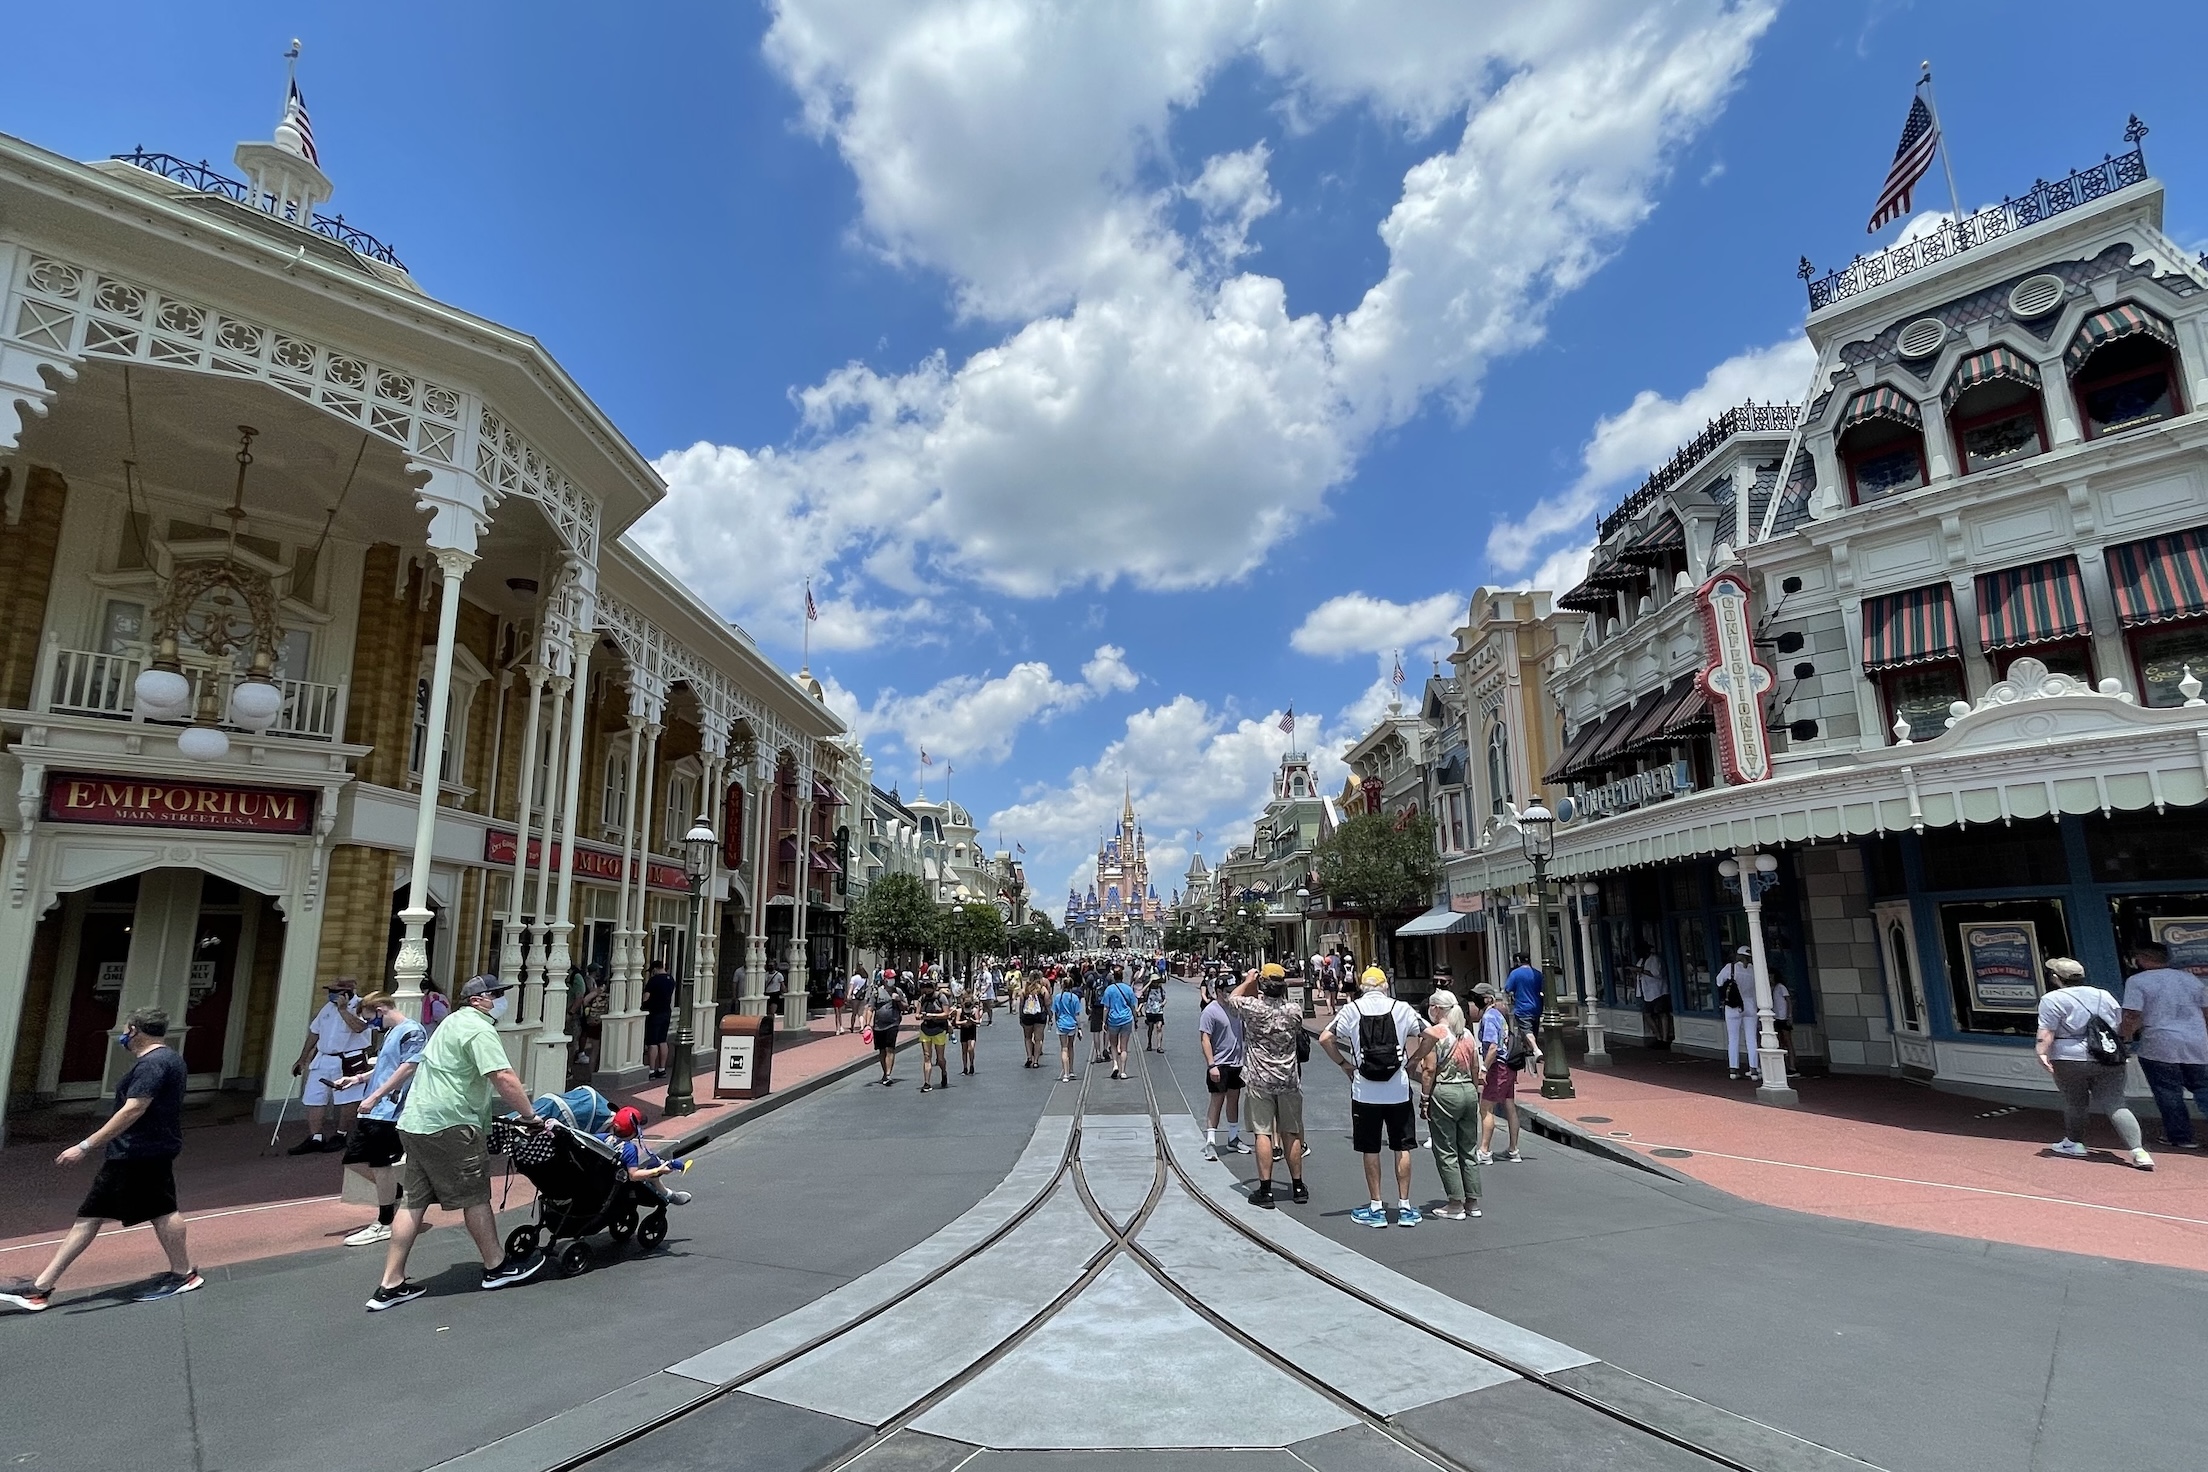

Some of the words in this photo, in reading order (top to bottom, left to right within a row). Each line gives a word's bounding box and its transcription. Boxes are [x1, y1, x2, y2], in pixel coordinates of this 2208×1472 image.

[1722, 597, 1758, 769] CONFECTIONERY
[65, 781, 297, 821] EMPORIUM
[115, 809, 156, 820] MAIN
[728, 790, 740, 860] EMPORIUM
[578, 851, 664, 883] MPOIM
[106, 965, 124, 973] EXI
[103, 973, 124, 981] ONL
[190, 971, 210, 979] NLY
[1980, 989, 2033, 997] CINEMA
